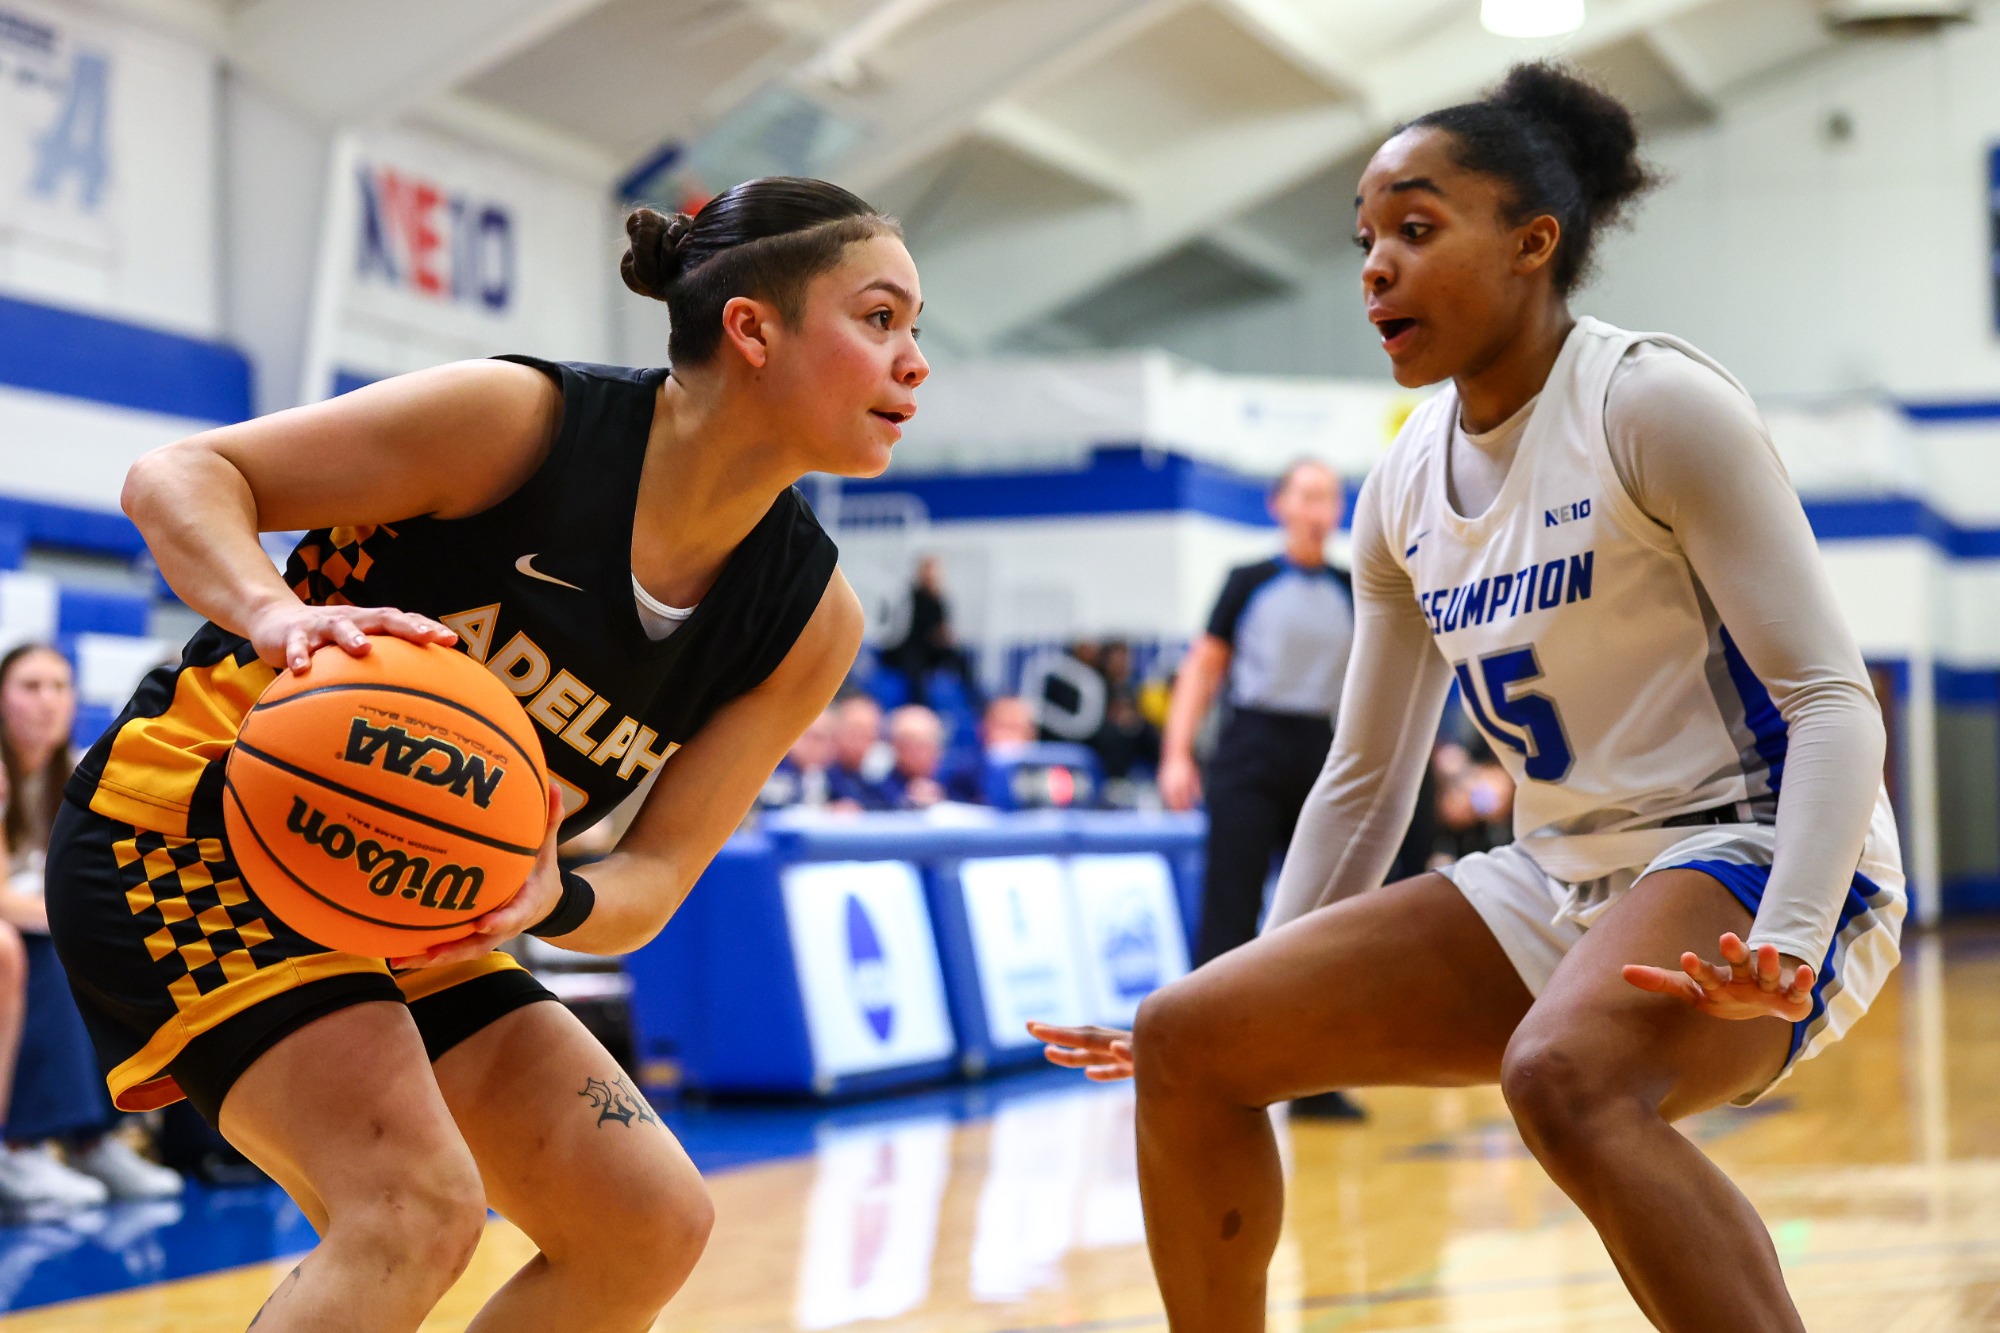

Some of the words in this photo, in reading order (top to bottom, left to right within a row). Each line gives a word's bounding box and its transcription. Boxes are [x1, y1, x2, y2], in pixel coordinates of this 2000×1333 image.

[1544, 498, 1592, 527] NE10
[358, 704, 400, 722] BALL
[403, 714, 449, 736] GAME
[1453, 642, 1576, 784] 15
[451, 731, 509, 765] OFFICIAL
[343, 716, 506, 811] NCAA
[346, 812, 371, 830] BALL
[373, 825, 404, 844] GAME
[406, 838, 448, 855] INDOOR
[286, 795, 486, 911] Wilson
